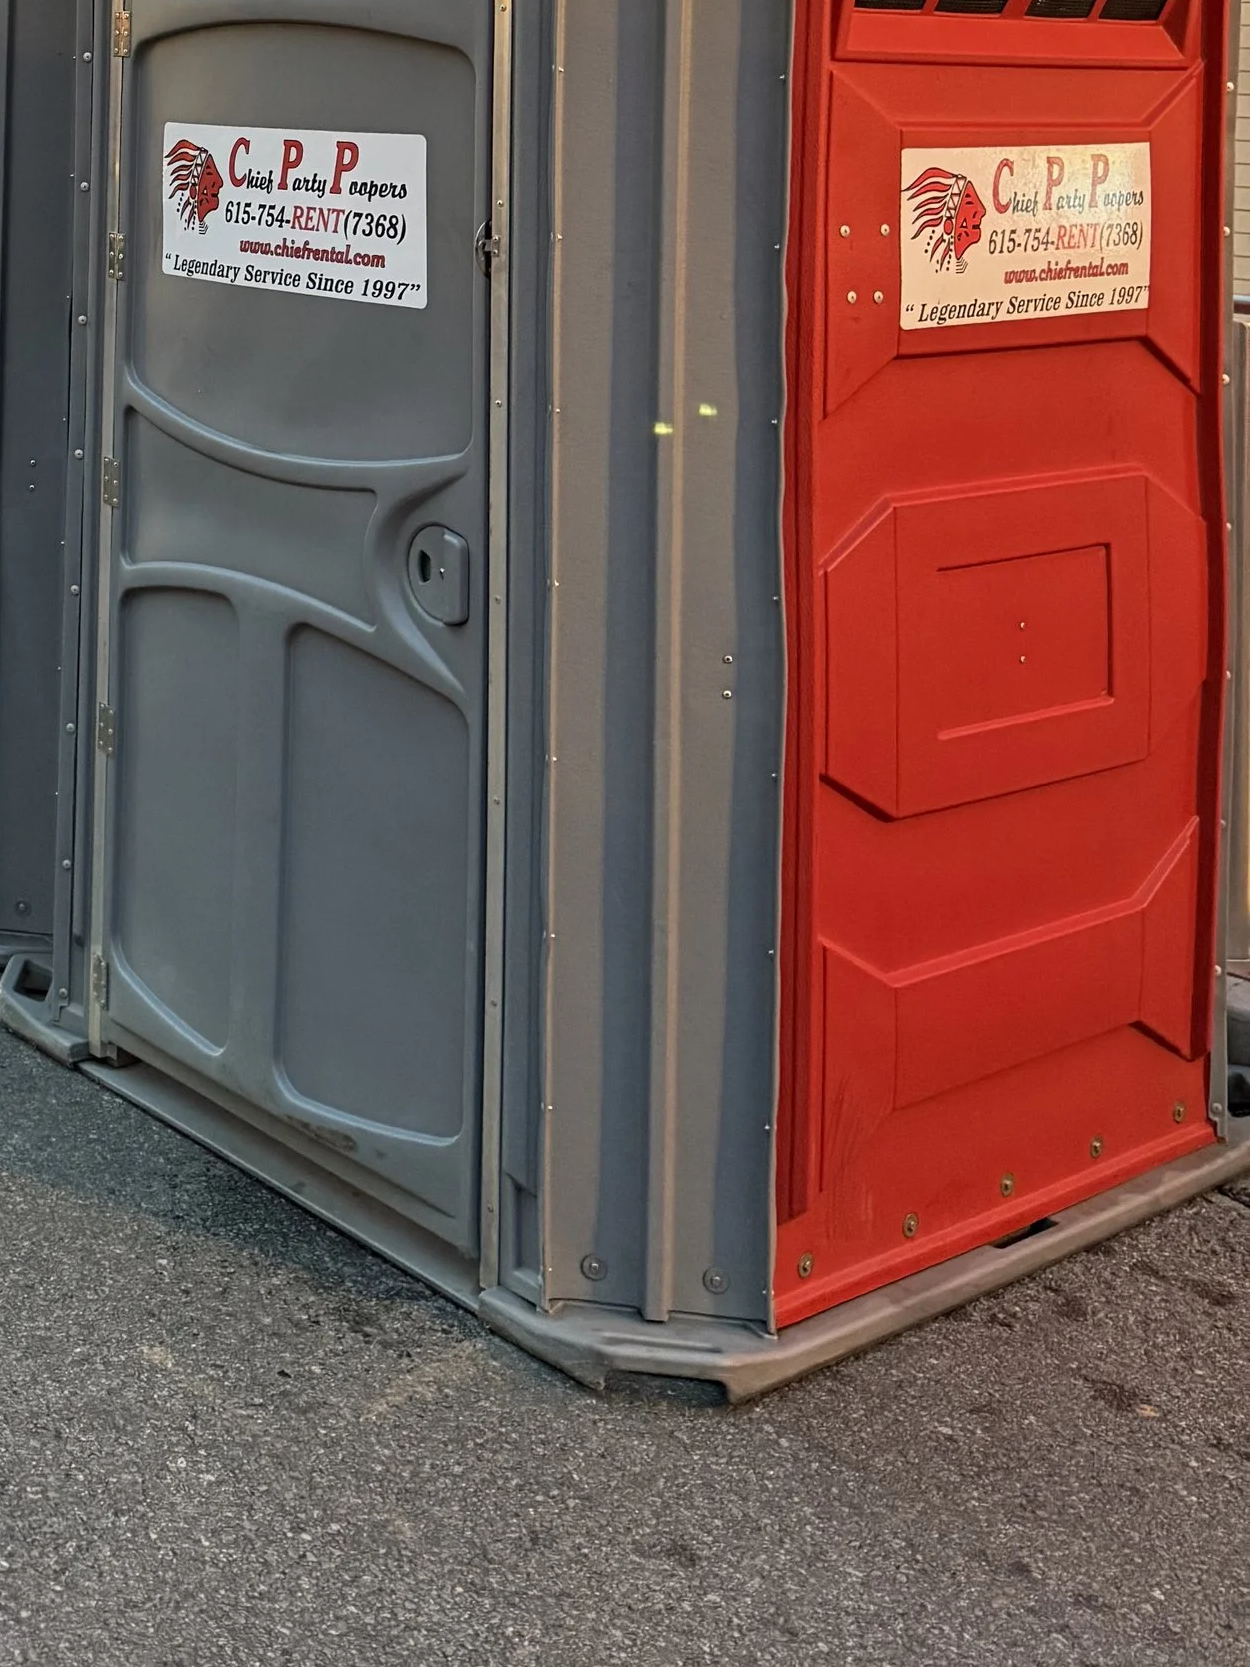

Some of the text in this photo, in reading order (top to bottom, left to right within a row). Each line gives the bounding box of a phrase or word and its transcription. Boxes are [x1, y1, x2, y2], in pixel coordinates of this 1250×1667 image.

[228, 137, 407, 202] Chief Party Poopers
[992, 154, 1144, 217] Chief Party Poopers
[225, 201, 406, 245] 615-754-RENT(7368)
[988, 220, 1144, 255] 615-754-RENT(7368)
[239, 238, 386, 268] www.chiefrental.com
[244, 264, 300, 288] Service
[306, 272, 353, 294] Since
[1004, 257, 1129, 284] www.chiefrental.com
[1006, 294, 1060, 315] Service
[1065, 290, 1104, 309] Since
